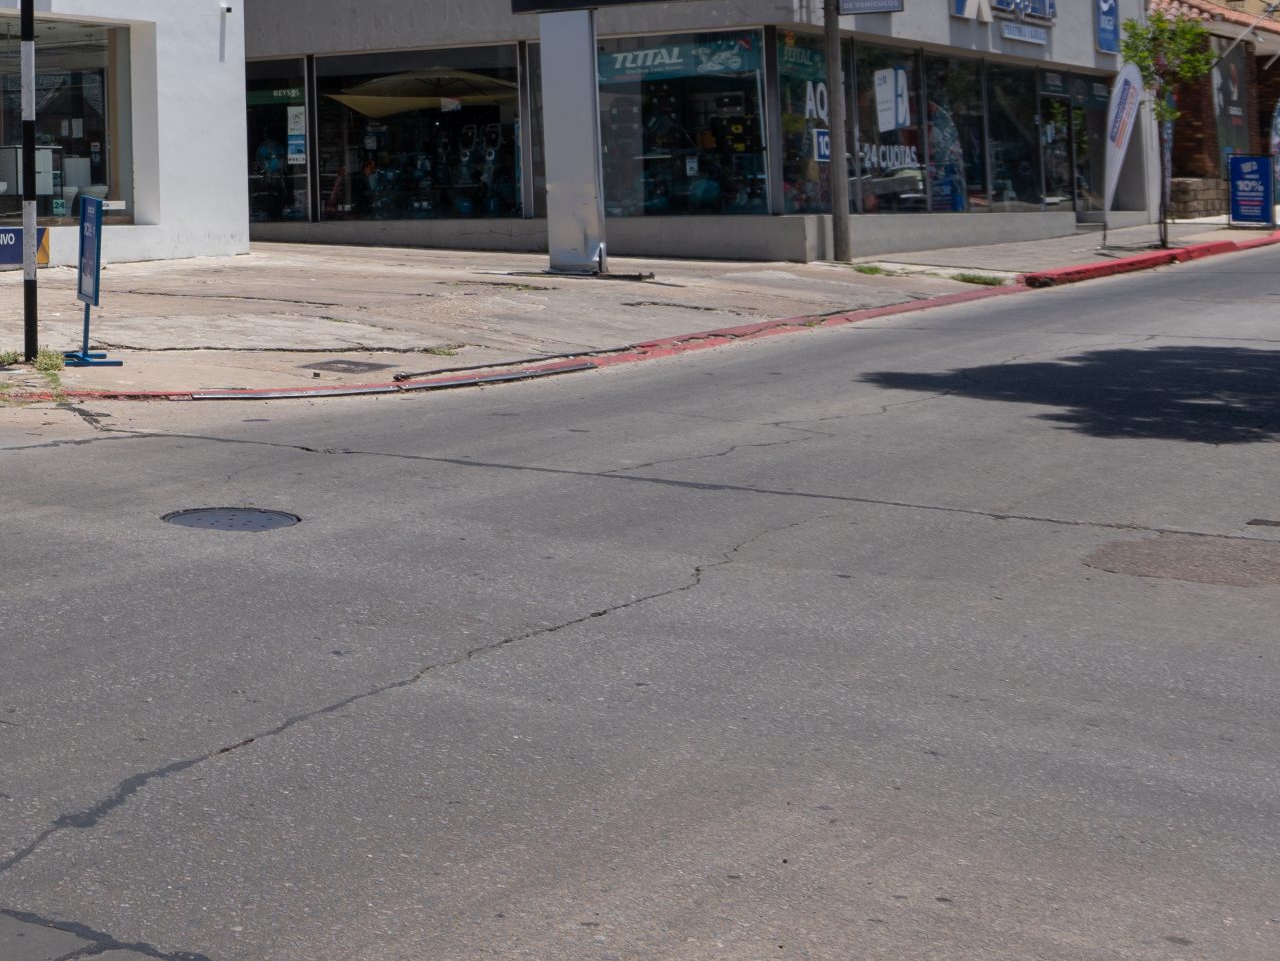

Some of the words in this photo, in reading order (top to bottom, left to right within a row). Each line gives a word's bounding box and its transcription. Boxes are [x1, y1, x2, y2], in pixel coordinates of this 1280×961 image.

[612, 47, 683, 69] TOTAL
[864, 143, 878, 168] 24
[880, 145, 918, 168] CUOTAS
[53, 201, 65, 209] 24
